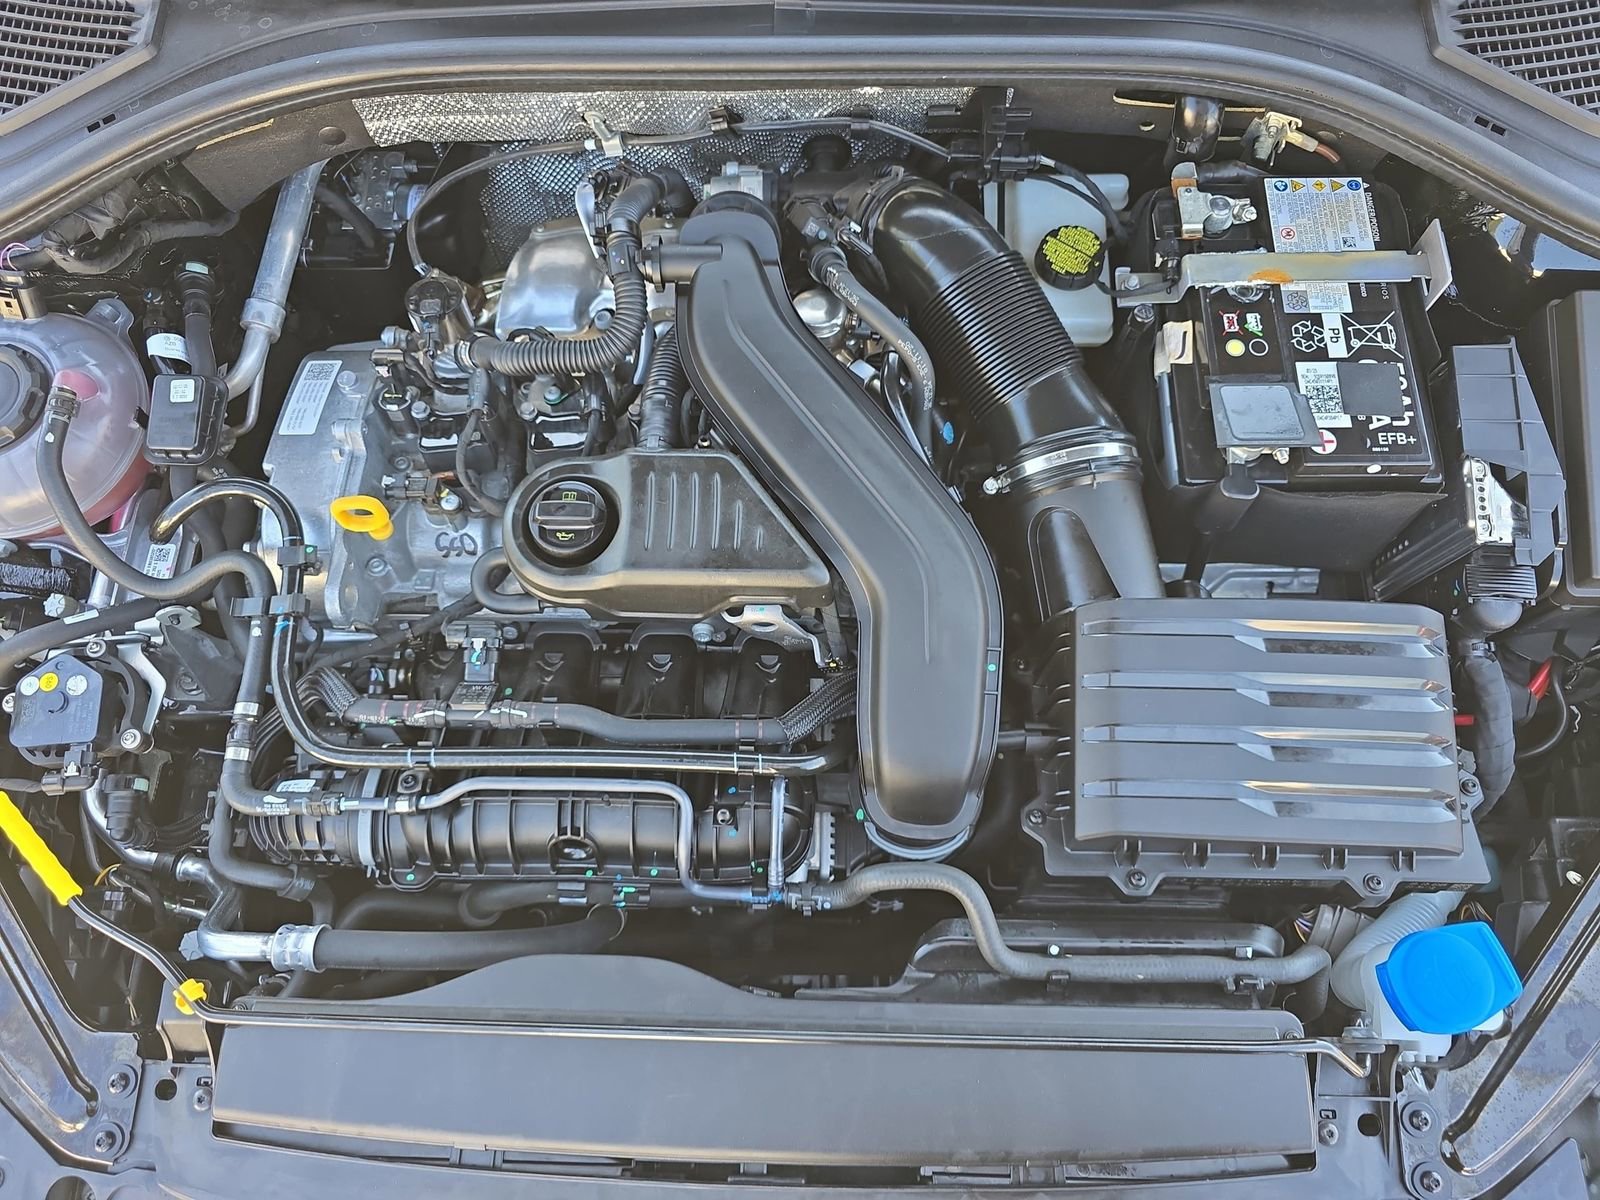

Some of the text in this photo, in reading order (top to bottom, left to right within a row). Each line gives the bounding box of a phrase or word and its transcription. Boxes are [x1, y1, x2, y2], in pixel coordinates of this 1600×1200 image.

[1365, 192, 1380, 242] DANGER/POISON
[1328, 328, 1341, 343] Pb
[1378, 432, 1417, 445] EFB+
